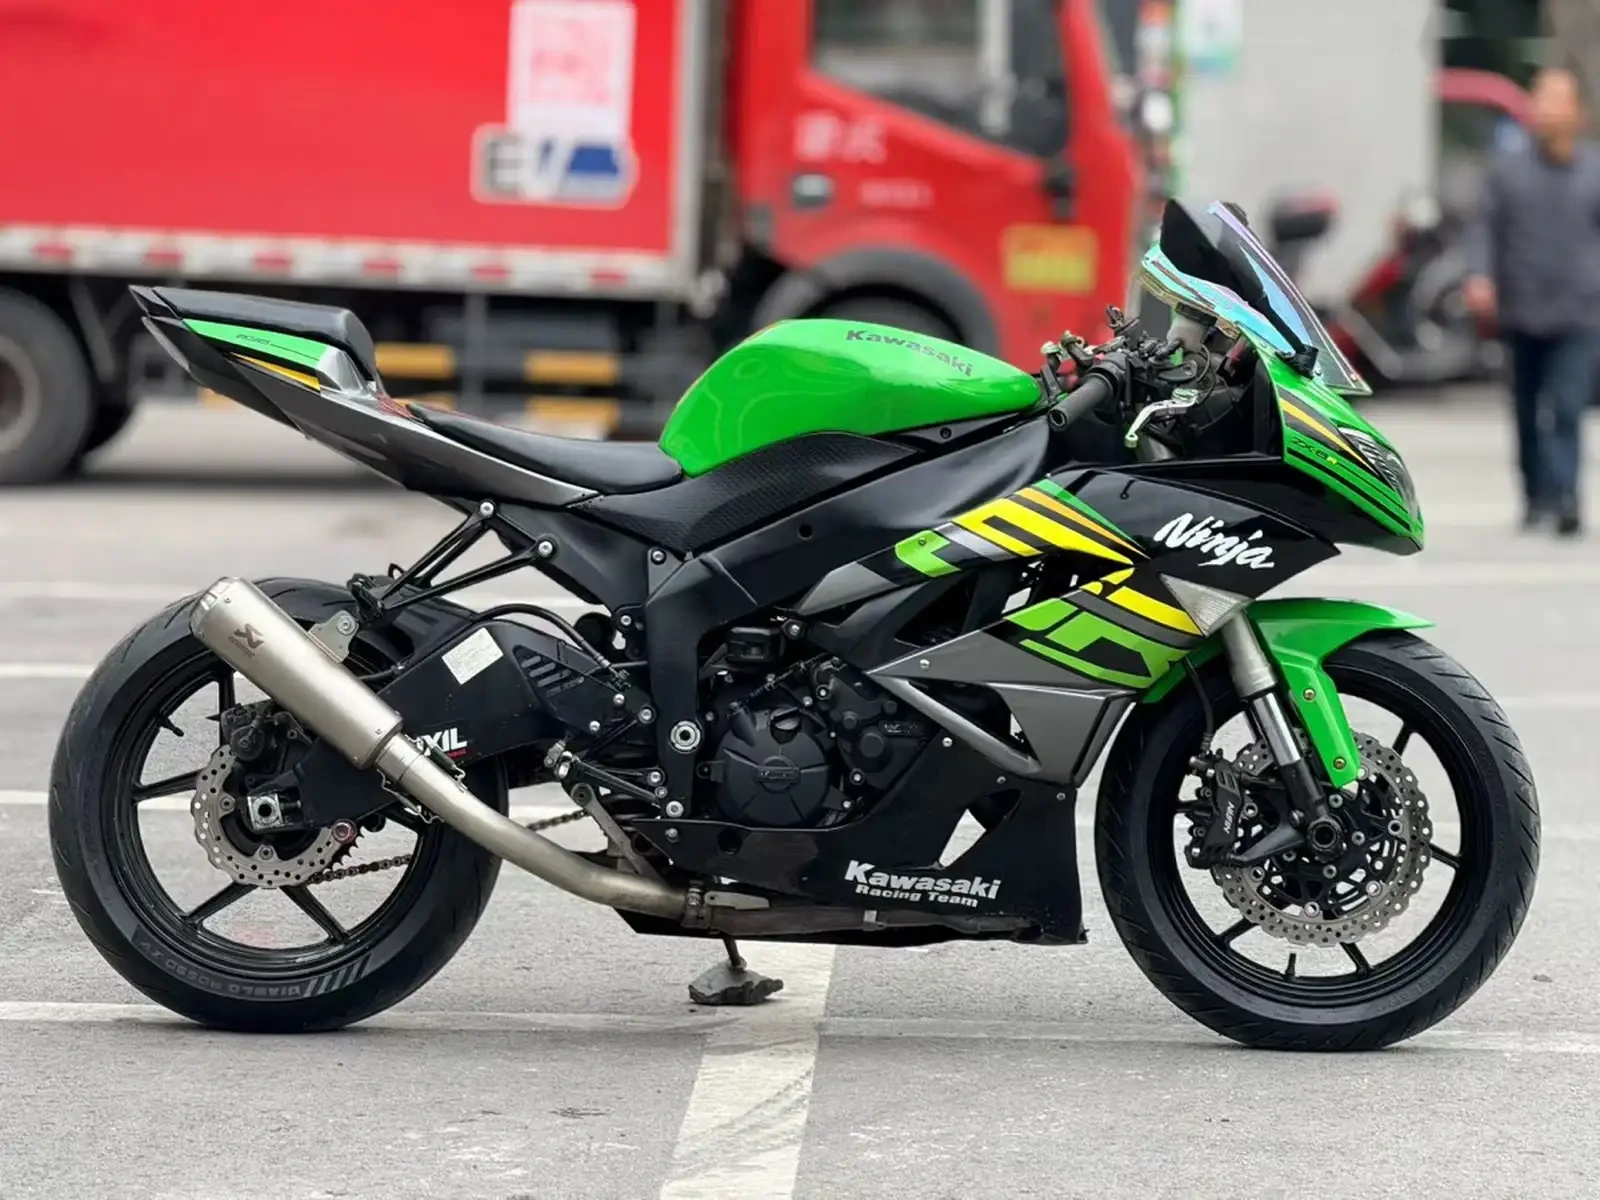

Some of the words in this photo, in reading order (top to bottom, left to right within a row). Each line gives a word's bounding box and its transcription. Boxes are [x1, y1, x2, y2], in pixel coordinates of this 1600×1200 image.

[846, 329, 973, 377] Kawasaki
[1152, 511, 1275, 570] Ninja
[416, 727, 468, 757] XIL
[844, 859, 1002, 900] Kawasaki
[854, 883, 922, 902] Racing
[927, 891, 979, 908] Team
